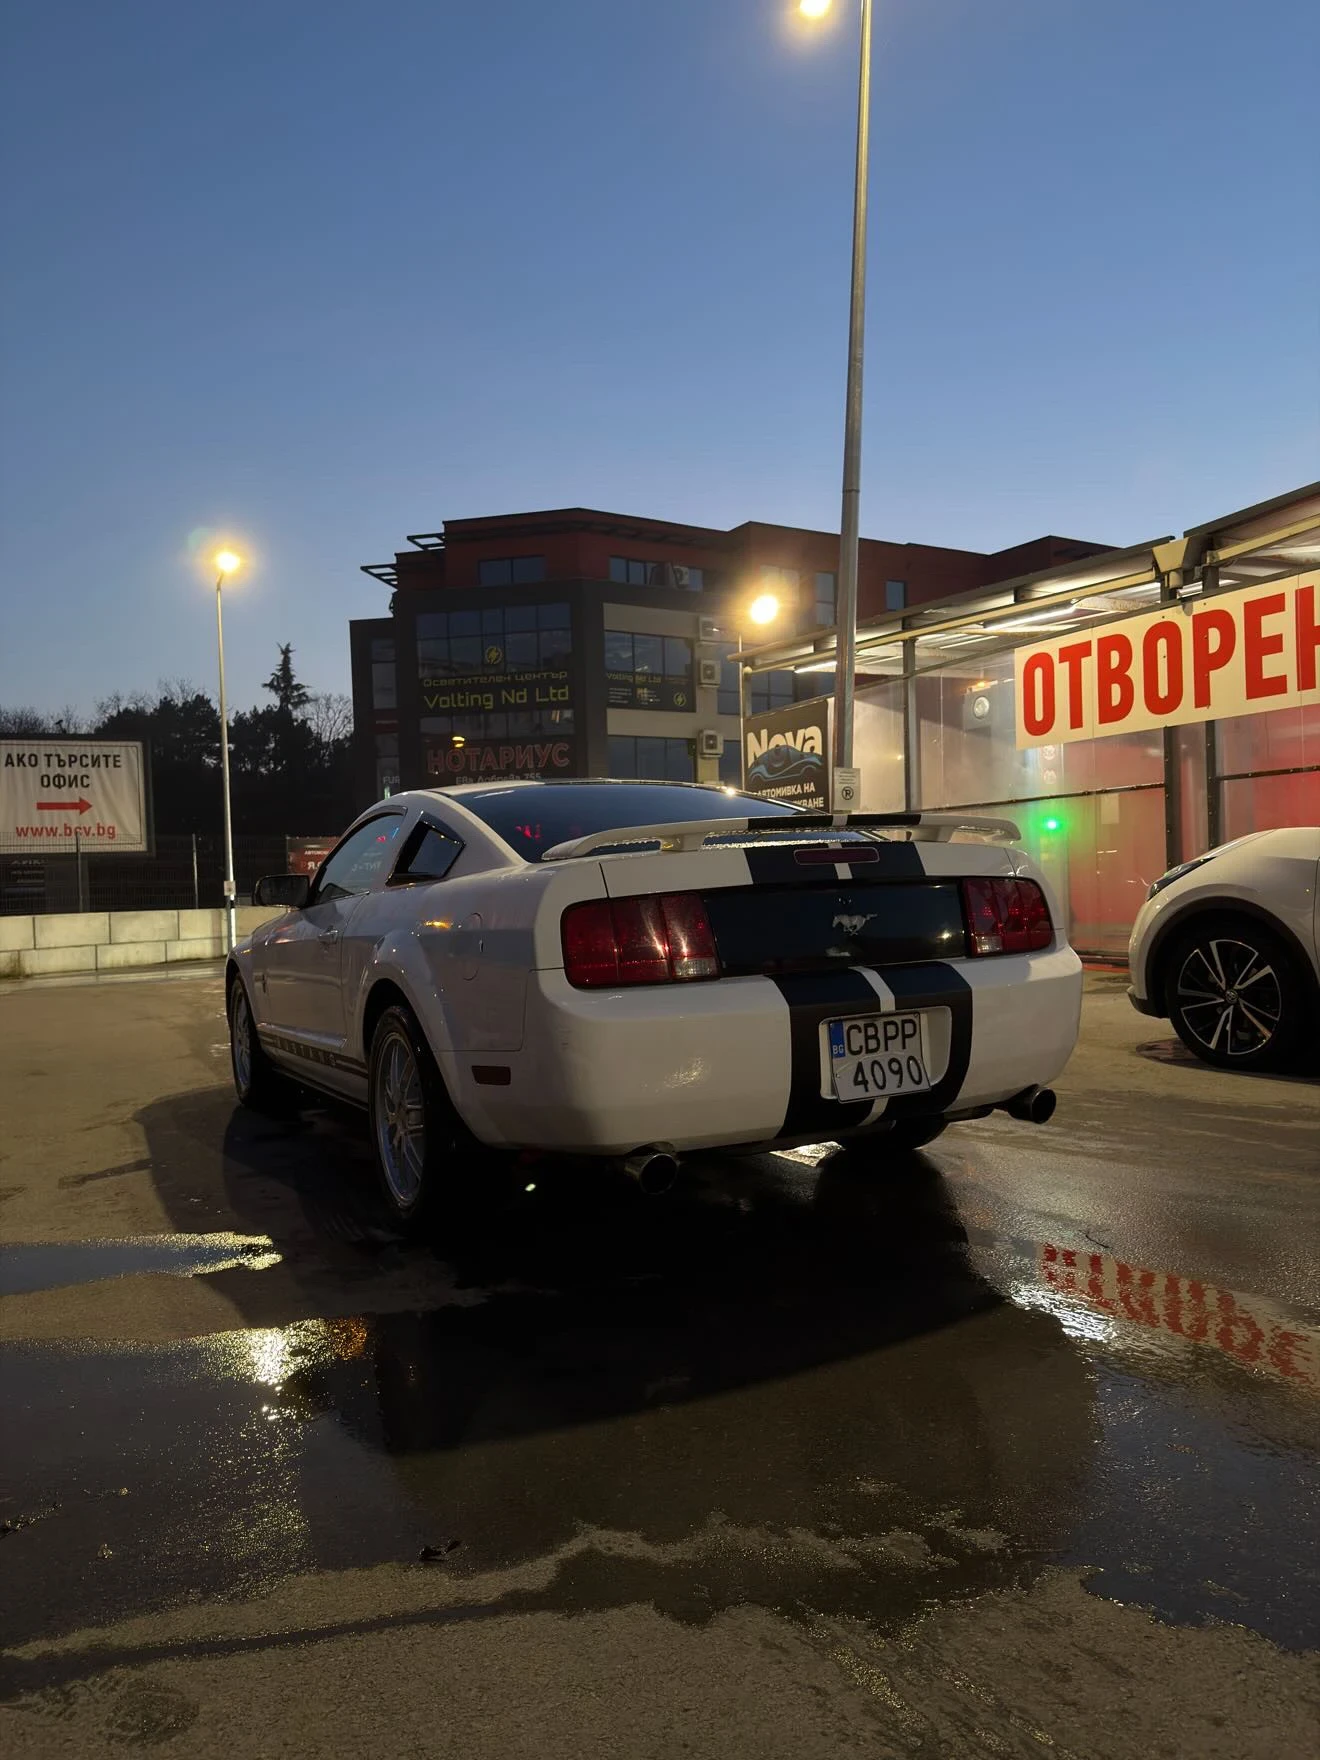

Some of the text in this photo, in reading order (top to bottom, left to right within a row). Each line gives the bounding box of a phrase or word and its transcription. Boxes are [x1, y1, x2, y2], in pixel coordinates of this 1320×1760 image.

[424, 685, 569, 709] Volting Nd Ltd
[427, 742, 570, 774] НОТАРИУС
[747, 725, 823, 769] Nova
[4, 753, 122, 768] АКО ТЪРСИТЕ
[40, 773, 91, 789] ОФИС
[803, 782, 816, 793] НА
[846, 1018, 917, 1056] CBPP
[832, 1044, 844, 1055] BG
[853, 1055, 922, 1093] 4090
